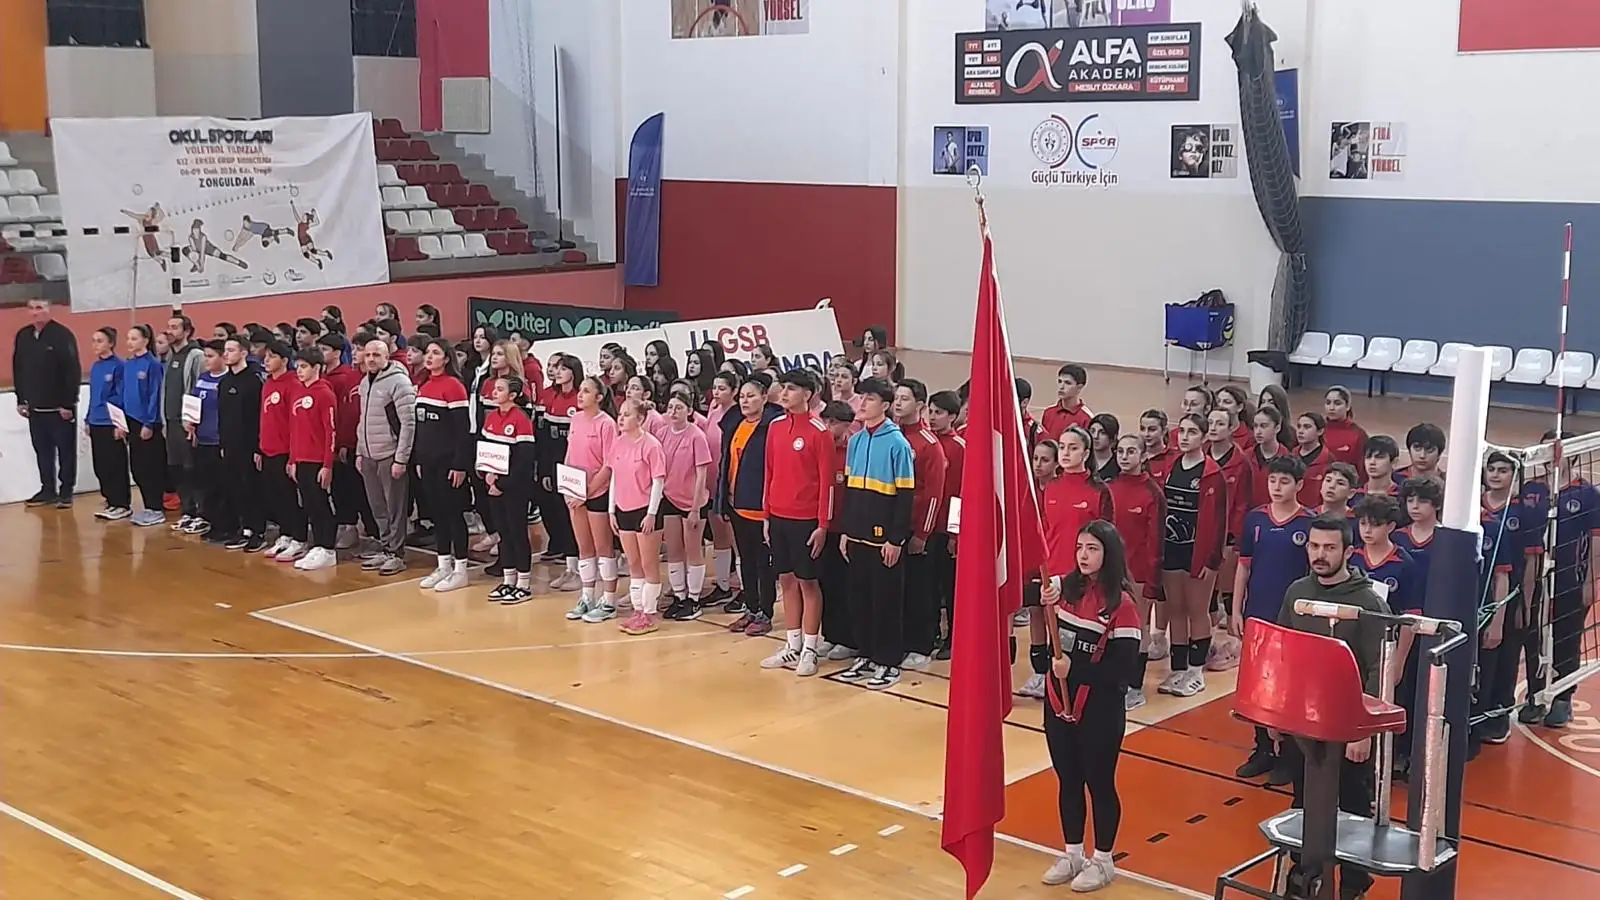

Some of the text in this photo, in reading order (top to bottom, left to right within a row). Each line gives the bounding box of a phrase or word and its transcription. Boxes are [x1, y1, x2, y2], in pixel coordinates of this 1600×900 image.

[1068, 38, 1142, 65] ALFA
[1075, 82, 1134, 91] MESUT ÖZKARA
[169, 129, 208, 144] OKUL
[1081, 137, 1117, 147] SPOR
[199, 177, 256, 188] ZONGULDAK
[1031, 167, 1118, 186] Güçlü Türkiye İçin
[504, 312, 551, 335] Butter
[718, 324, 770, 354] GSB
